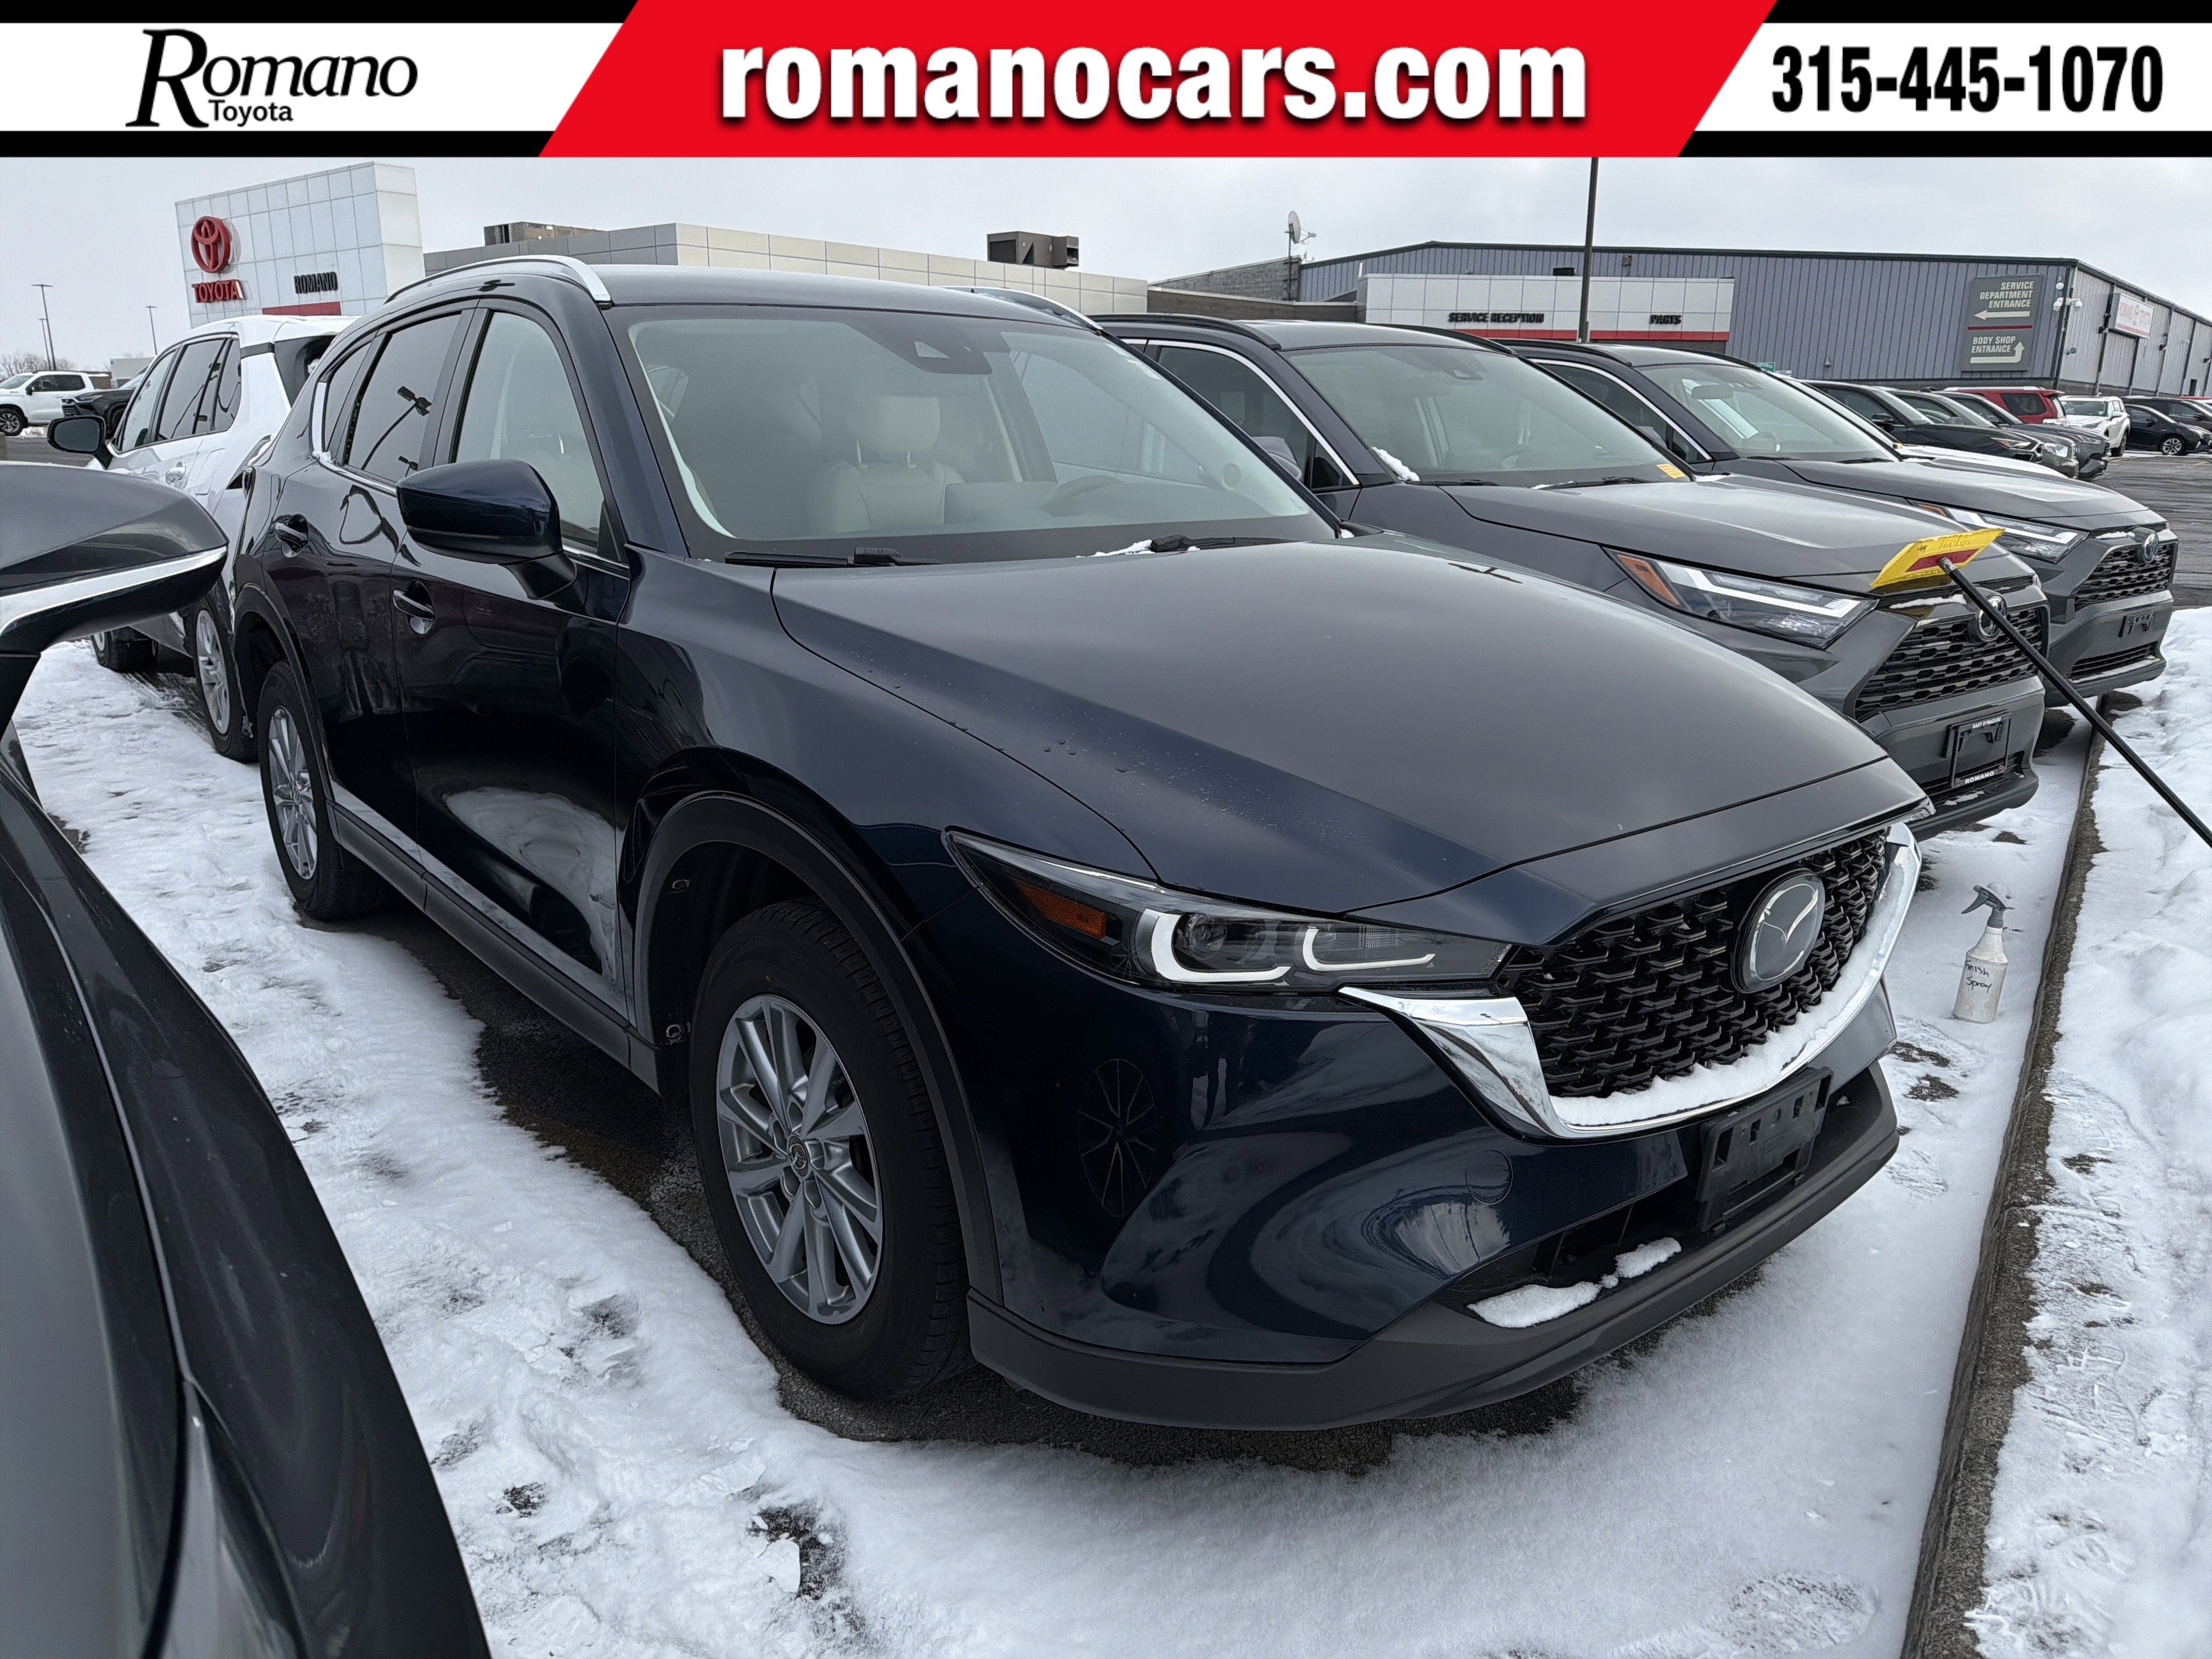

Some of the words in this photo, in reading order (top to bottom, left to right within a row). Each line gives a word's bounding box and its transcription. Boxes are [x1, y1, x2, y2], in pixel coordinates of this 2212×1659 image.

[293, 272, 338, 295] ROMANO
[2000, 281, 2034, 290] SERVICE
[191, 279, 245, 303] TOYOTA
[1979, 290, 2033, 300] DEPARTMENT
[1989, 299, 2032, 308] ENTRANCE
[1448, 312, 1489, 323] SERVICE
[1490, 313, 1545, 323] RECEPTION
[1650, 314, 1682, 325] PARTS
[1973, 336, 1994, 345] BODY
[1995, 336, 2016, 344] SHOP
[1971, 345, 2012, 353] ENTRANCE
[1965, 770, 1995, 785] ROMANO
[1966, 976, 1992, 994] Spray
